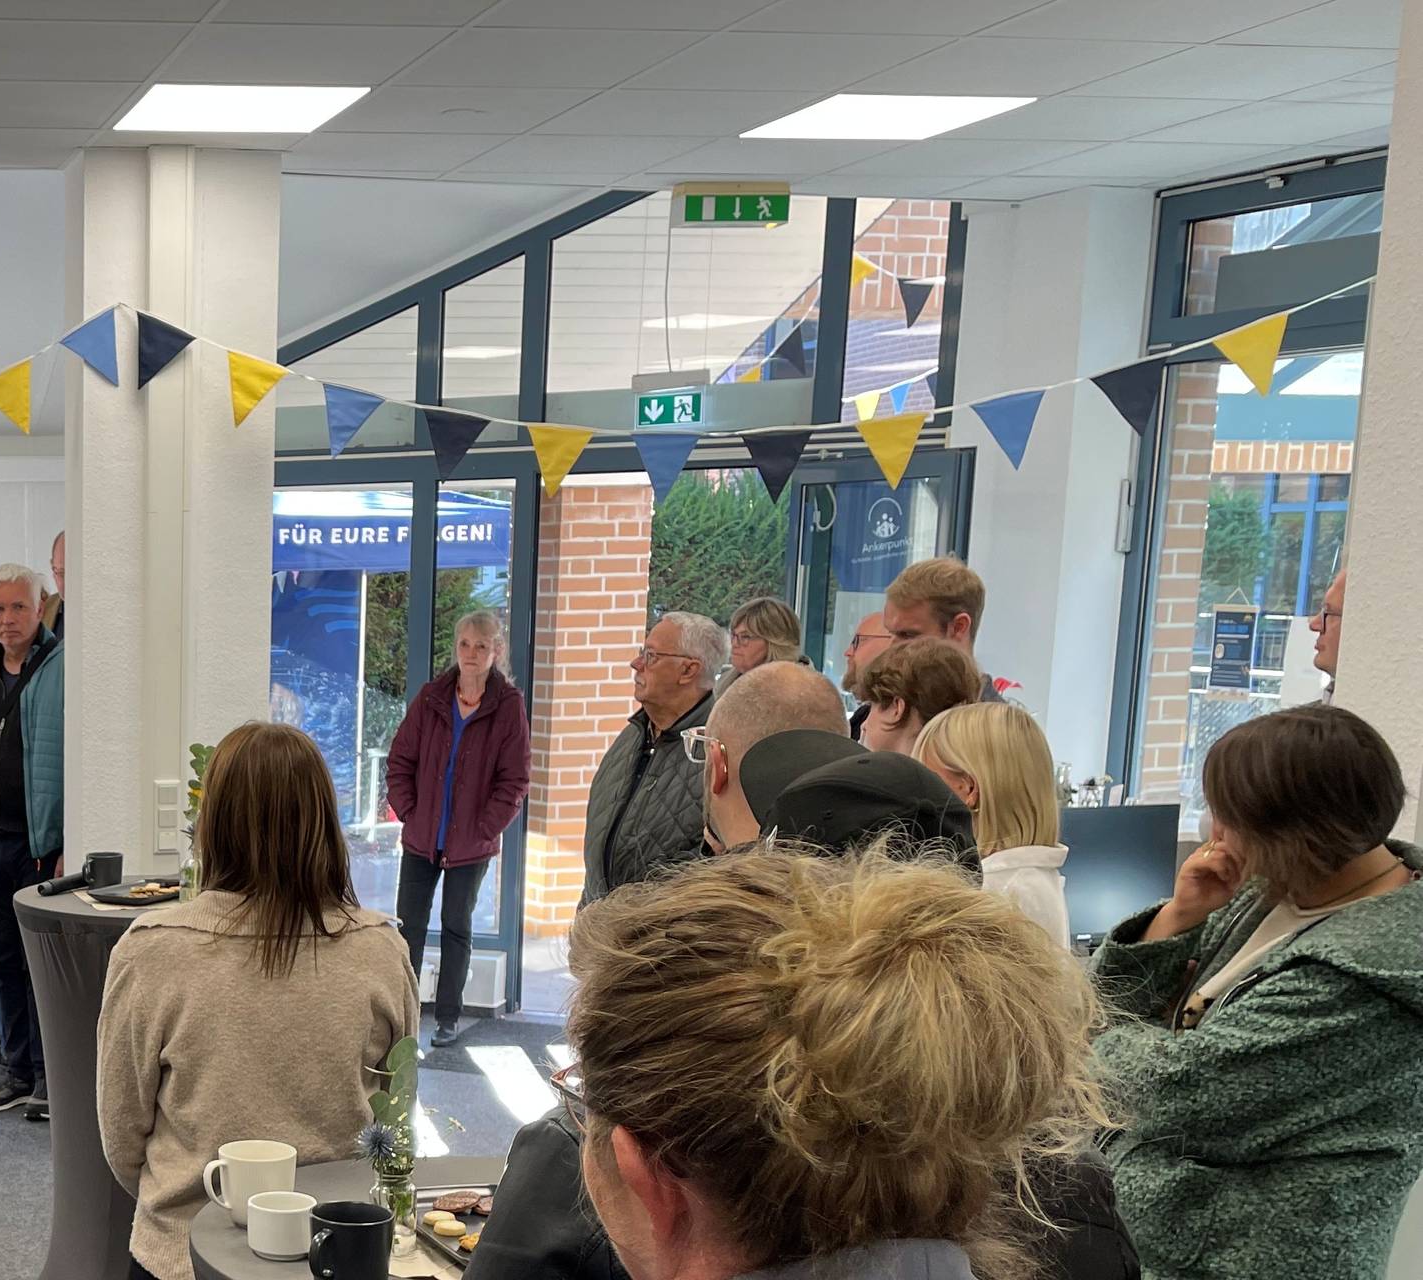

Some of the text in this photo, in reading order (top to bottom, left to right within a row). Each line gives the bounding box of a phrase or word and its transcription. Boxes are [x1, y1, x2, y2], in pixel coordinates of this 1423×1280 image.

[278, 523, 493, 545] FÜR EURE FGEN!
